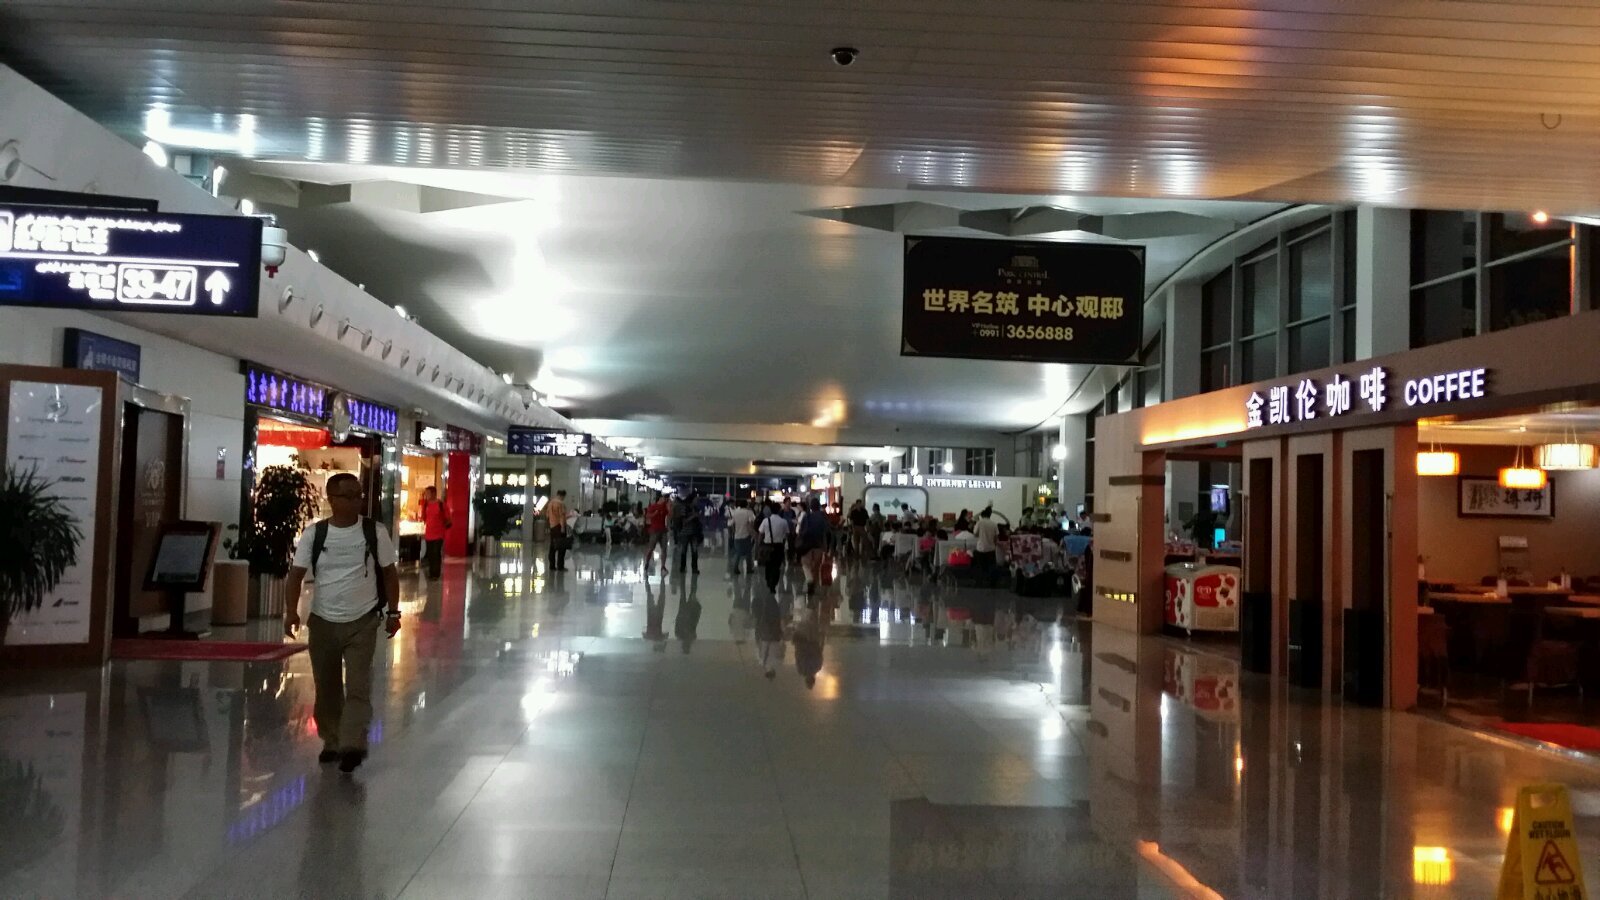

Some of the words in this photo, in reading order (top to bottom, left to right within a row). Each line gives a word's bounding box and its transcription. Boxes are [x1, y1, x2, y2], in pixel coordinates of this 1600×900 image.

[922, 288, 1020, 316] 世界名筑
[1027, 293, 1124, 320] 中心观邸
[979, 329, 1000, 338] 0991
[1006, 324, 1074, 341] 3656888
[1245, 366, 1387, 428] 金凯伦咖啡
[1404, 368, 1486, 407] COFFEE
[926, 478, 967, 489] INTERNET
[1532, 820, 1566, 830] CAUTION
